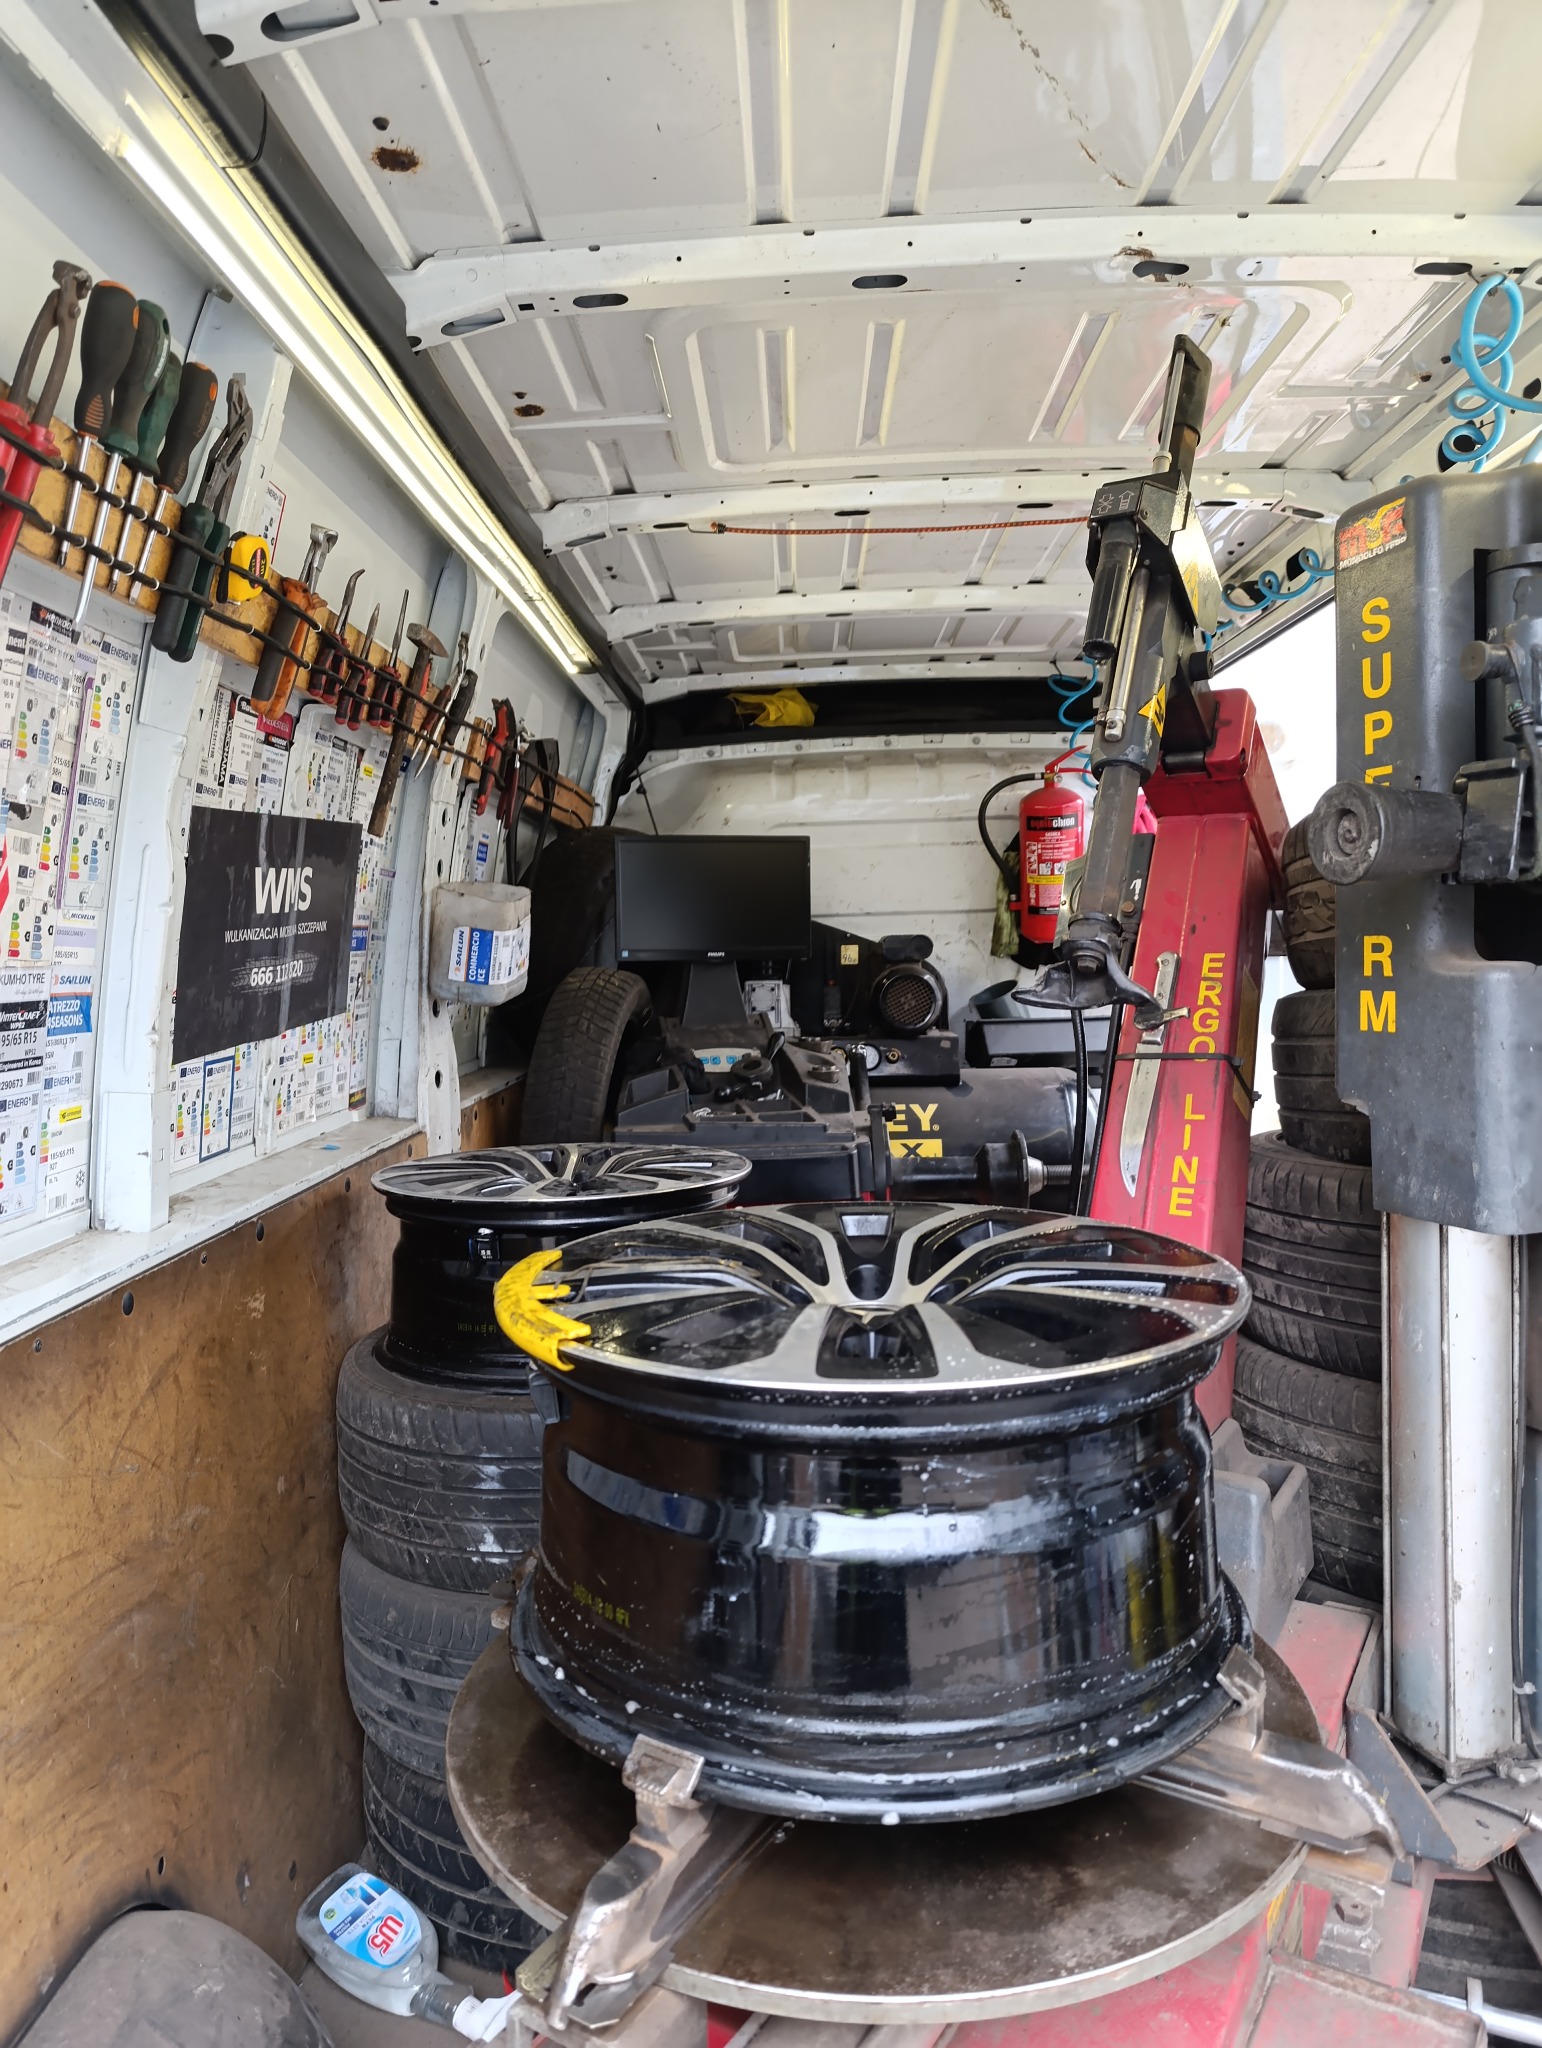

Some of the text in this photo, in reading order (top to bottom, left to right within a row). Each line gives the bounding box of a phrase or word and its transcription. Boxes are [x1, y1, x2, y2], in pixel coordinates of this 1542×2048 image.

[110, 645, 128, 661] ENERG
[219, 719, 234, 783] YOKOHAMA
[255, 866, 313, 914] WMS
[225, 927, 279, 943] WULKANIZACJA
[297, 920, 328, 935] SZCZEPANIK
[456, 930, 465, 966] SAILUN
[469, 931, 480, 981] COMMERCIO
[28, 973, 45, 984] TYRE
[60, 975, 92, 985] SAILUN
[250, 966, 274, 987] 666
[477, 968, 486, 982] ICE
[49, 1000, 80, 1013] ATREZZO
[23, 1031, 37, 1044] R15
[0, 1061, 23, 1072] Engineered
[1168, 953, 1226, 1217] ERGO LINE
[8, 1097, 28, 1109] ENERG
[368, 1914, 404, 1956] W5
